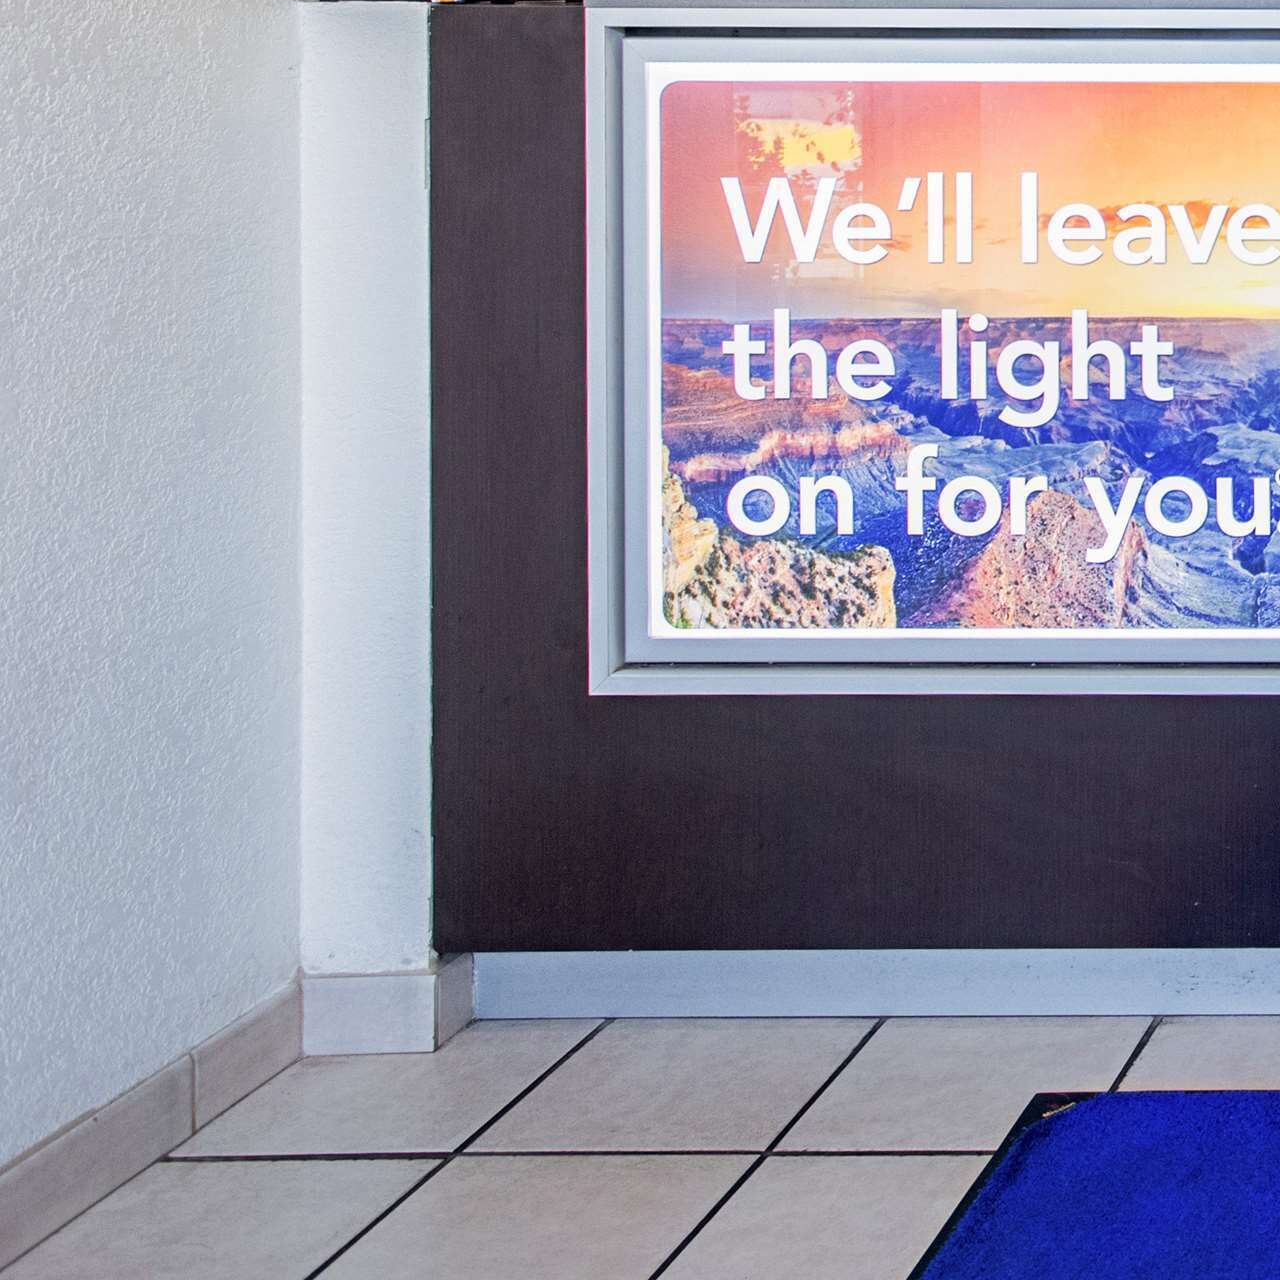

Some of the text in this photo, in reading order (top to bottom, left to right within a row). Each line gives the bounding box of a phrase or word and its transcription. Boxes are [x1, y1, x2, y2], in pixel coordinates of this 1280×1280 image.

[721, 171, 973, 264] We'll
[721, 308, 1175, 428] the light
[726, 473, 853, 538] on
[896, 444, 1043, 538] for
